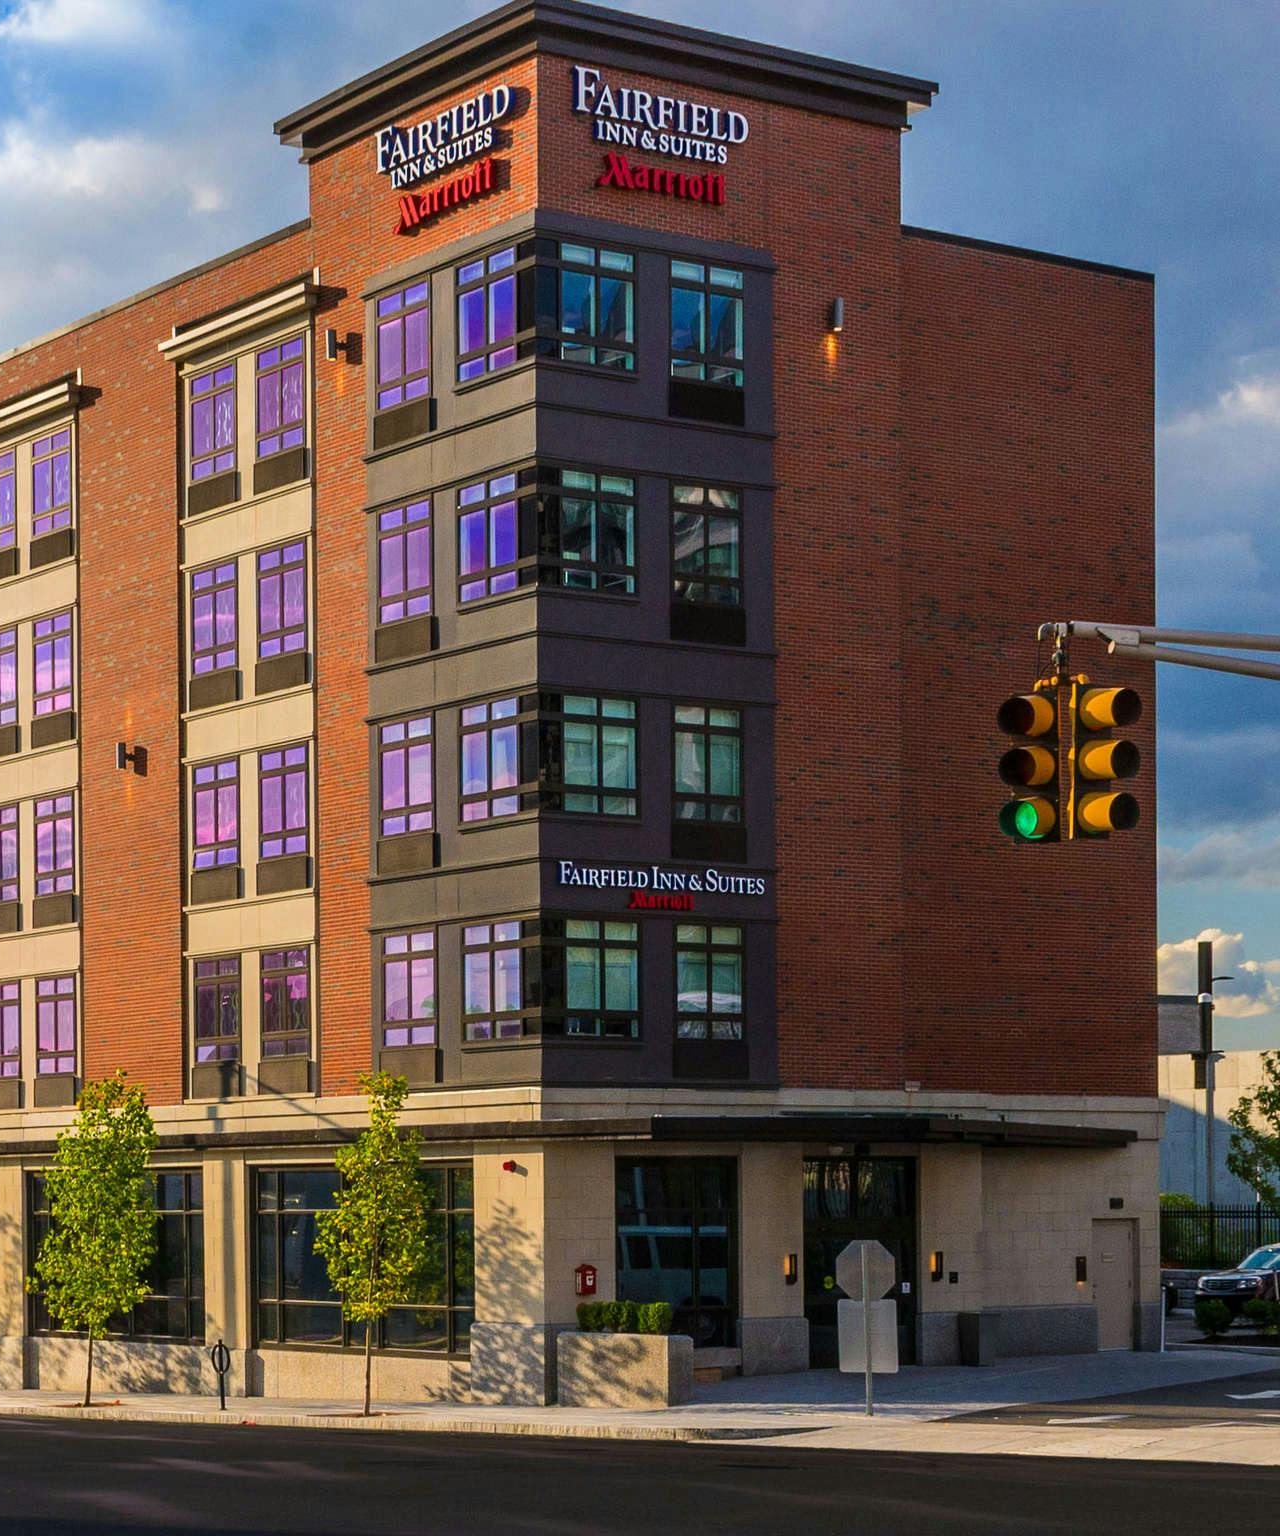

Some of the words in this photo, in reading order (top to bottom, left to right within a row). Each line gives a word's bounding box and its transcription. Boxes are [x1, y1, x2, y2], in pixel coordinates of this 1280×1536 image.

[374, 84, 512, 174] FAIRFIELD
[574, 65, 750, 144] FAIRFIELD
[390, 159, 422, 190] INN
[423, 154, 437, 175] &
[437, 127, 494, 170] SUITES
[595, 119, 638, 147] INN
[640, 130, 657, 151] &
[658, 133, 728, 165] SUITES
[393, 157, 495, 235] Marriott
[597, 150, 725, 205] Marriott
[559, 861, 649, 889] FAIRFIELD
[651, 866, 687, 891] INN
[688, 873, 704, 892] &
[705, 869, 766, 896] SUITES
[628, 890, 695, 912] Marriott
